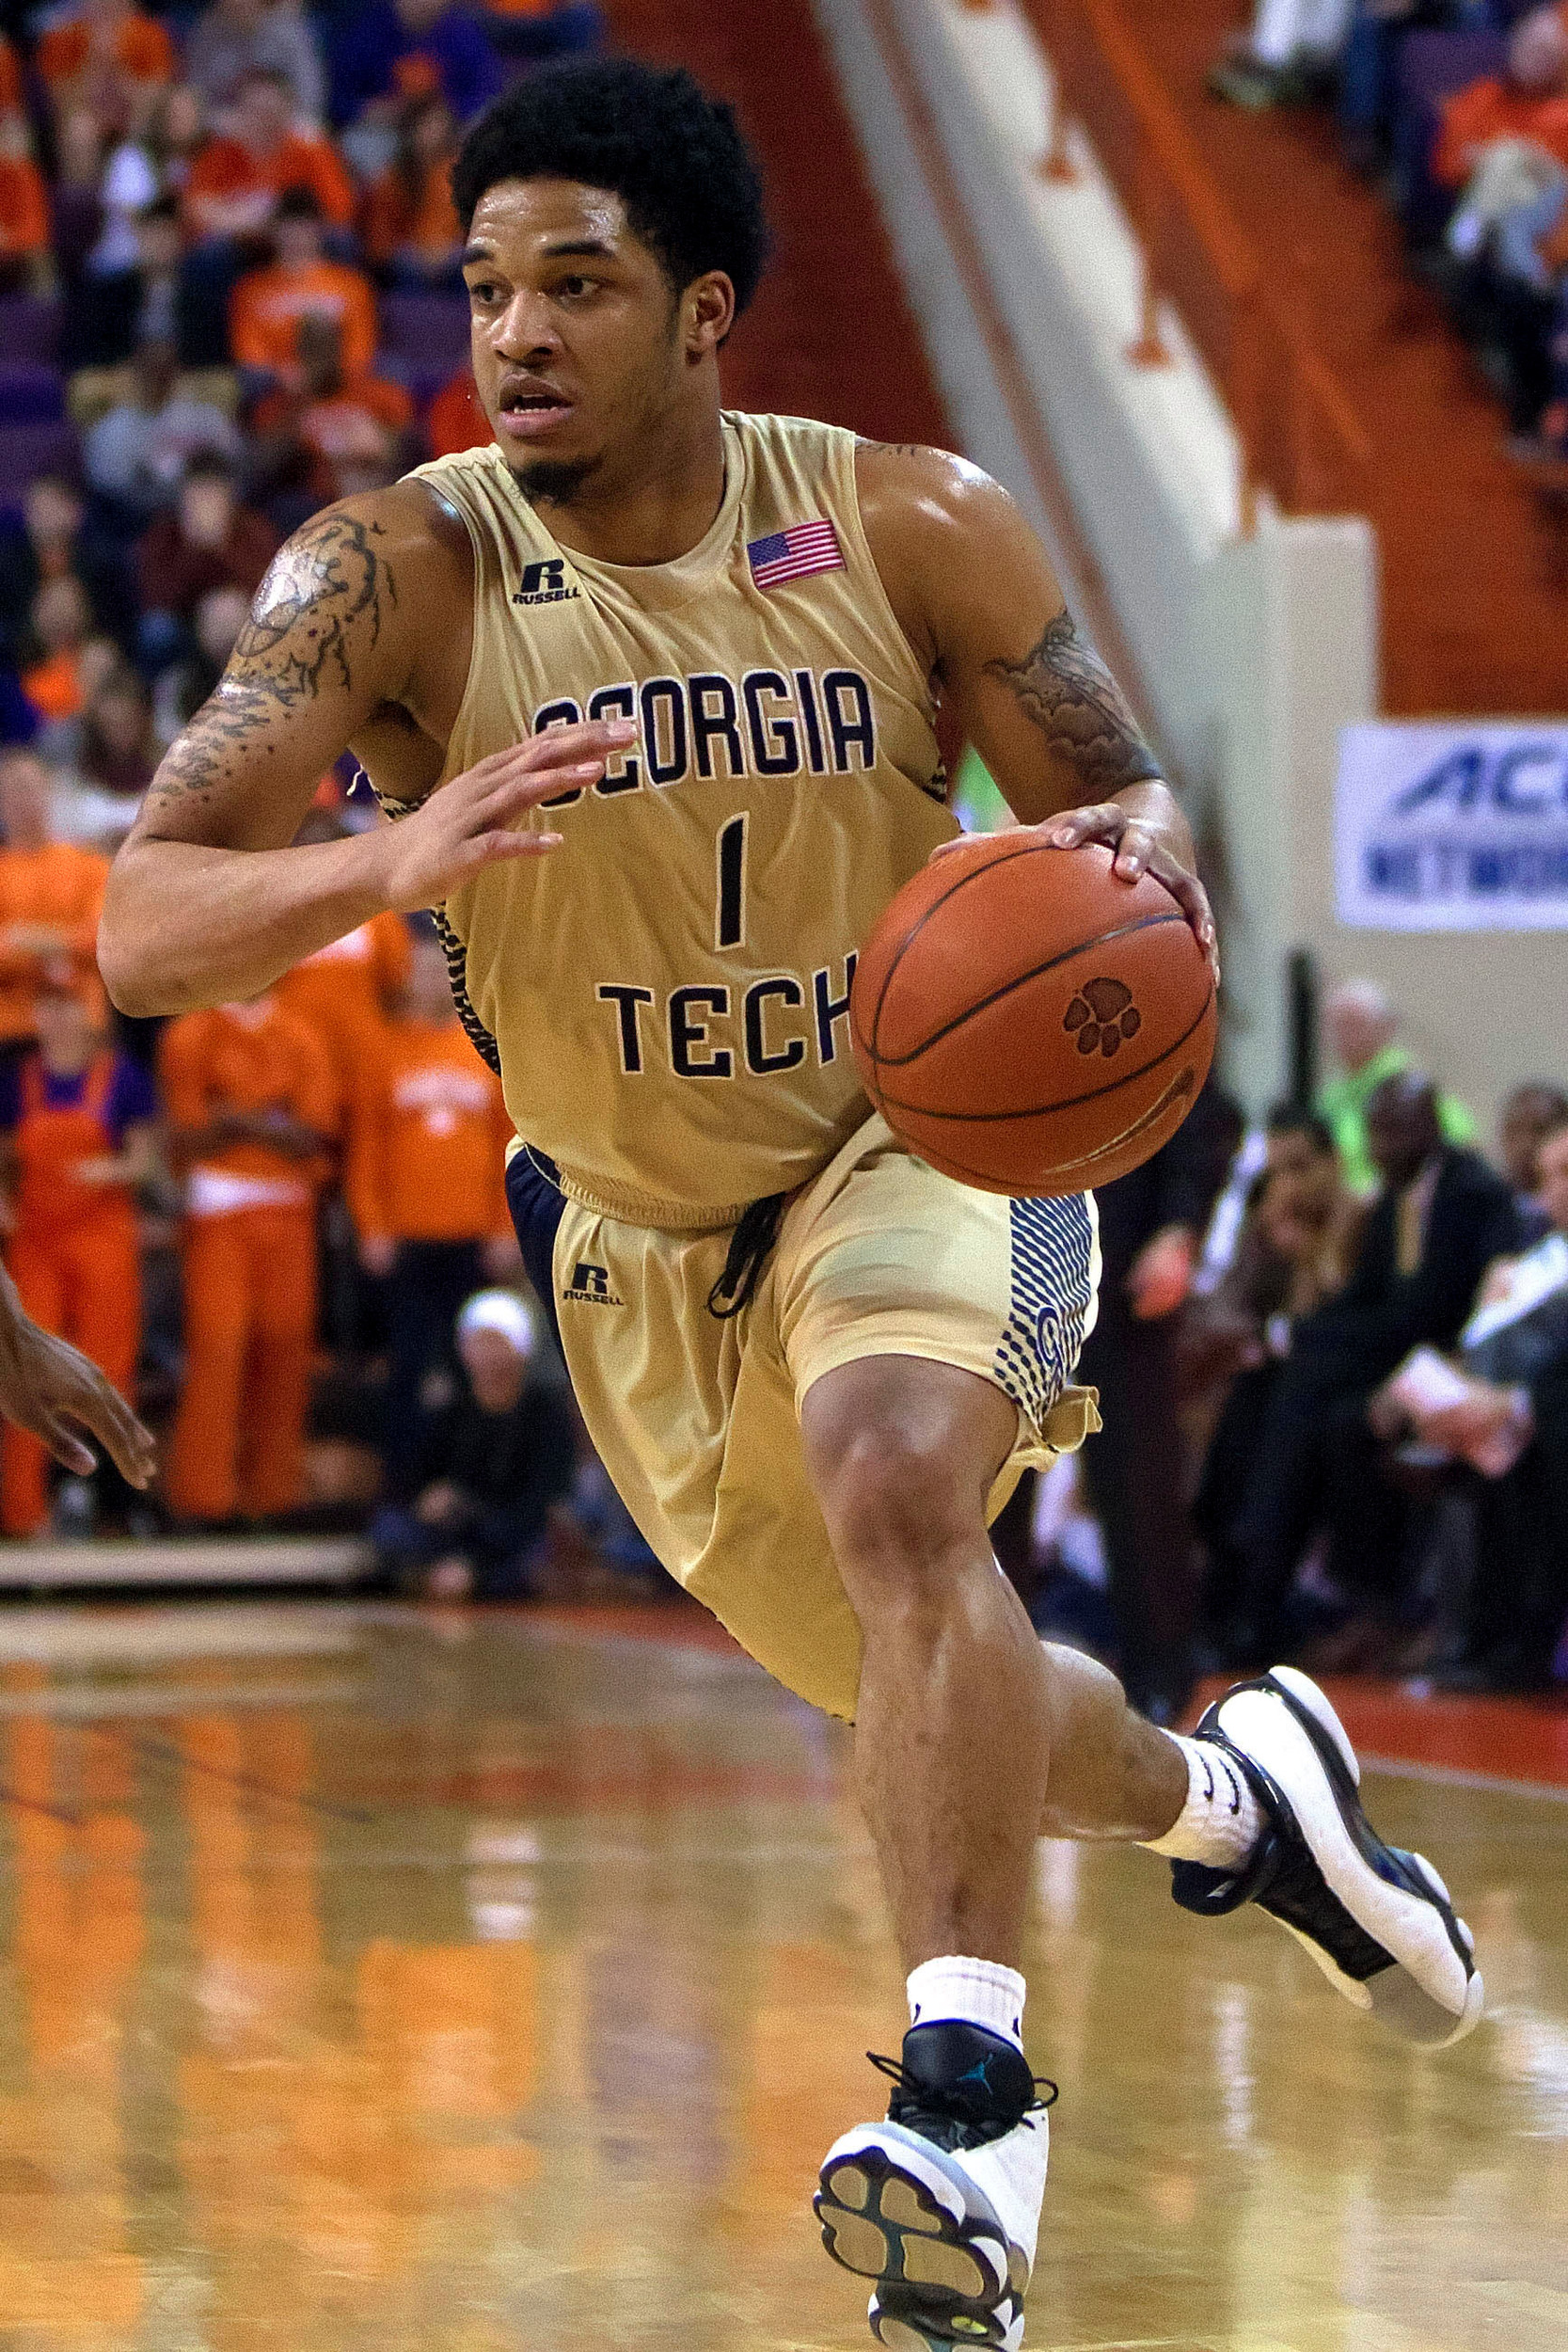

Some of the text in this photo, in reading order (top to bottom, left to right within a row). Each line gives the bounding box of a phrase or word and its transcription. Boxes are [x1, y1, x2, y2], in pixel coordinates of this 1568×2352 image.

[512, 586, 581, 605] RUSSELL
[1392, 746, 1568, 817] AC
[714, 810, 751, 952] 1
[594, 948, 860, 1080] TECH
[562, 1290, 625, 1307] RUSSELL
